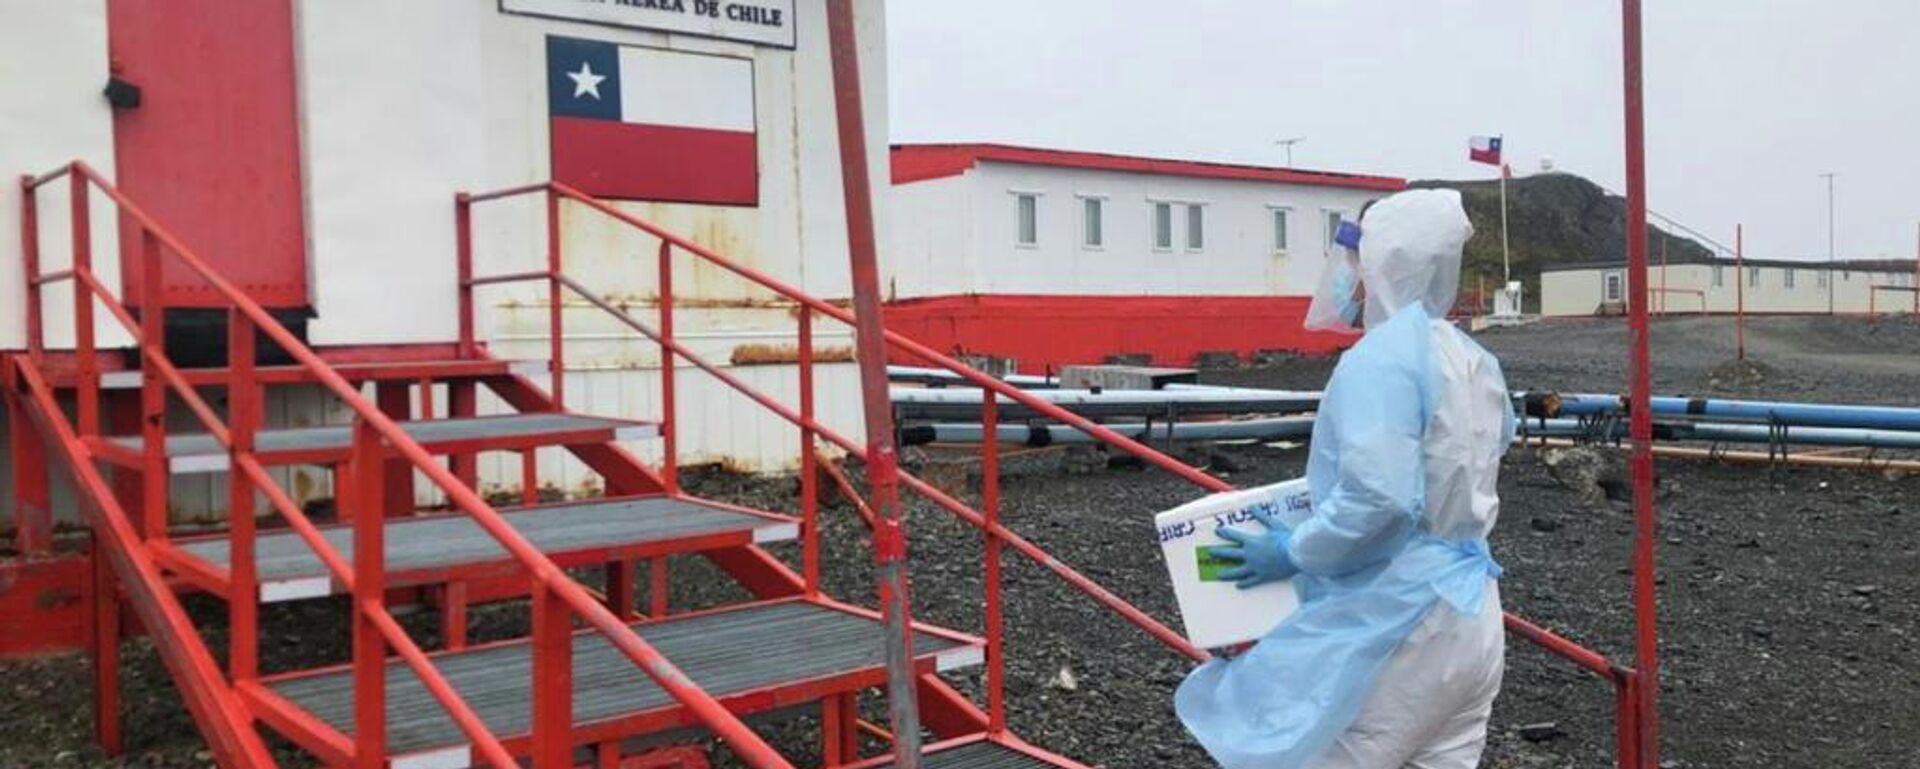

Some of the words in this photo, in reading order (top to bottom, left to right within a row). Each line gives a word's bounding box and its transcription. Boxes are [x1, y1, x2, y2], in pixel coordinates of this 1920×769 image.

[615, 0, 685, 13] REA
[694, 0, 719, 18] DE
[726, 4, 782, 26] CHILE
